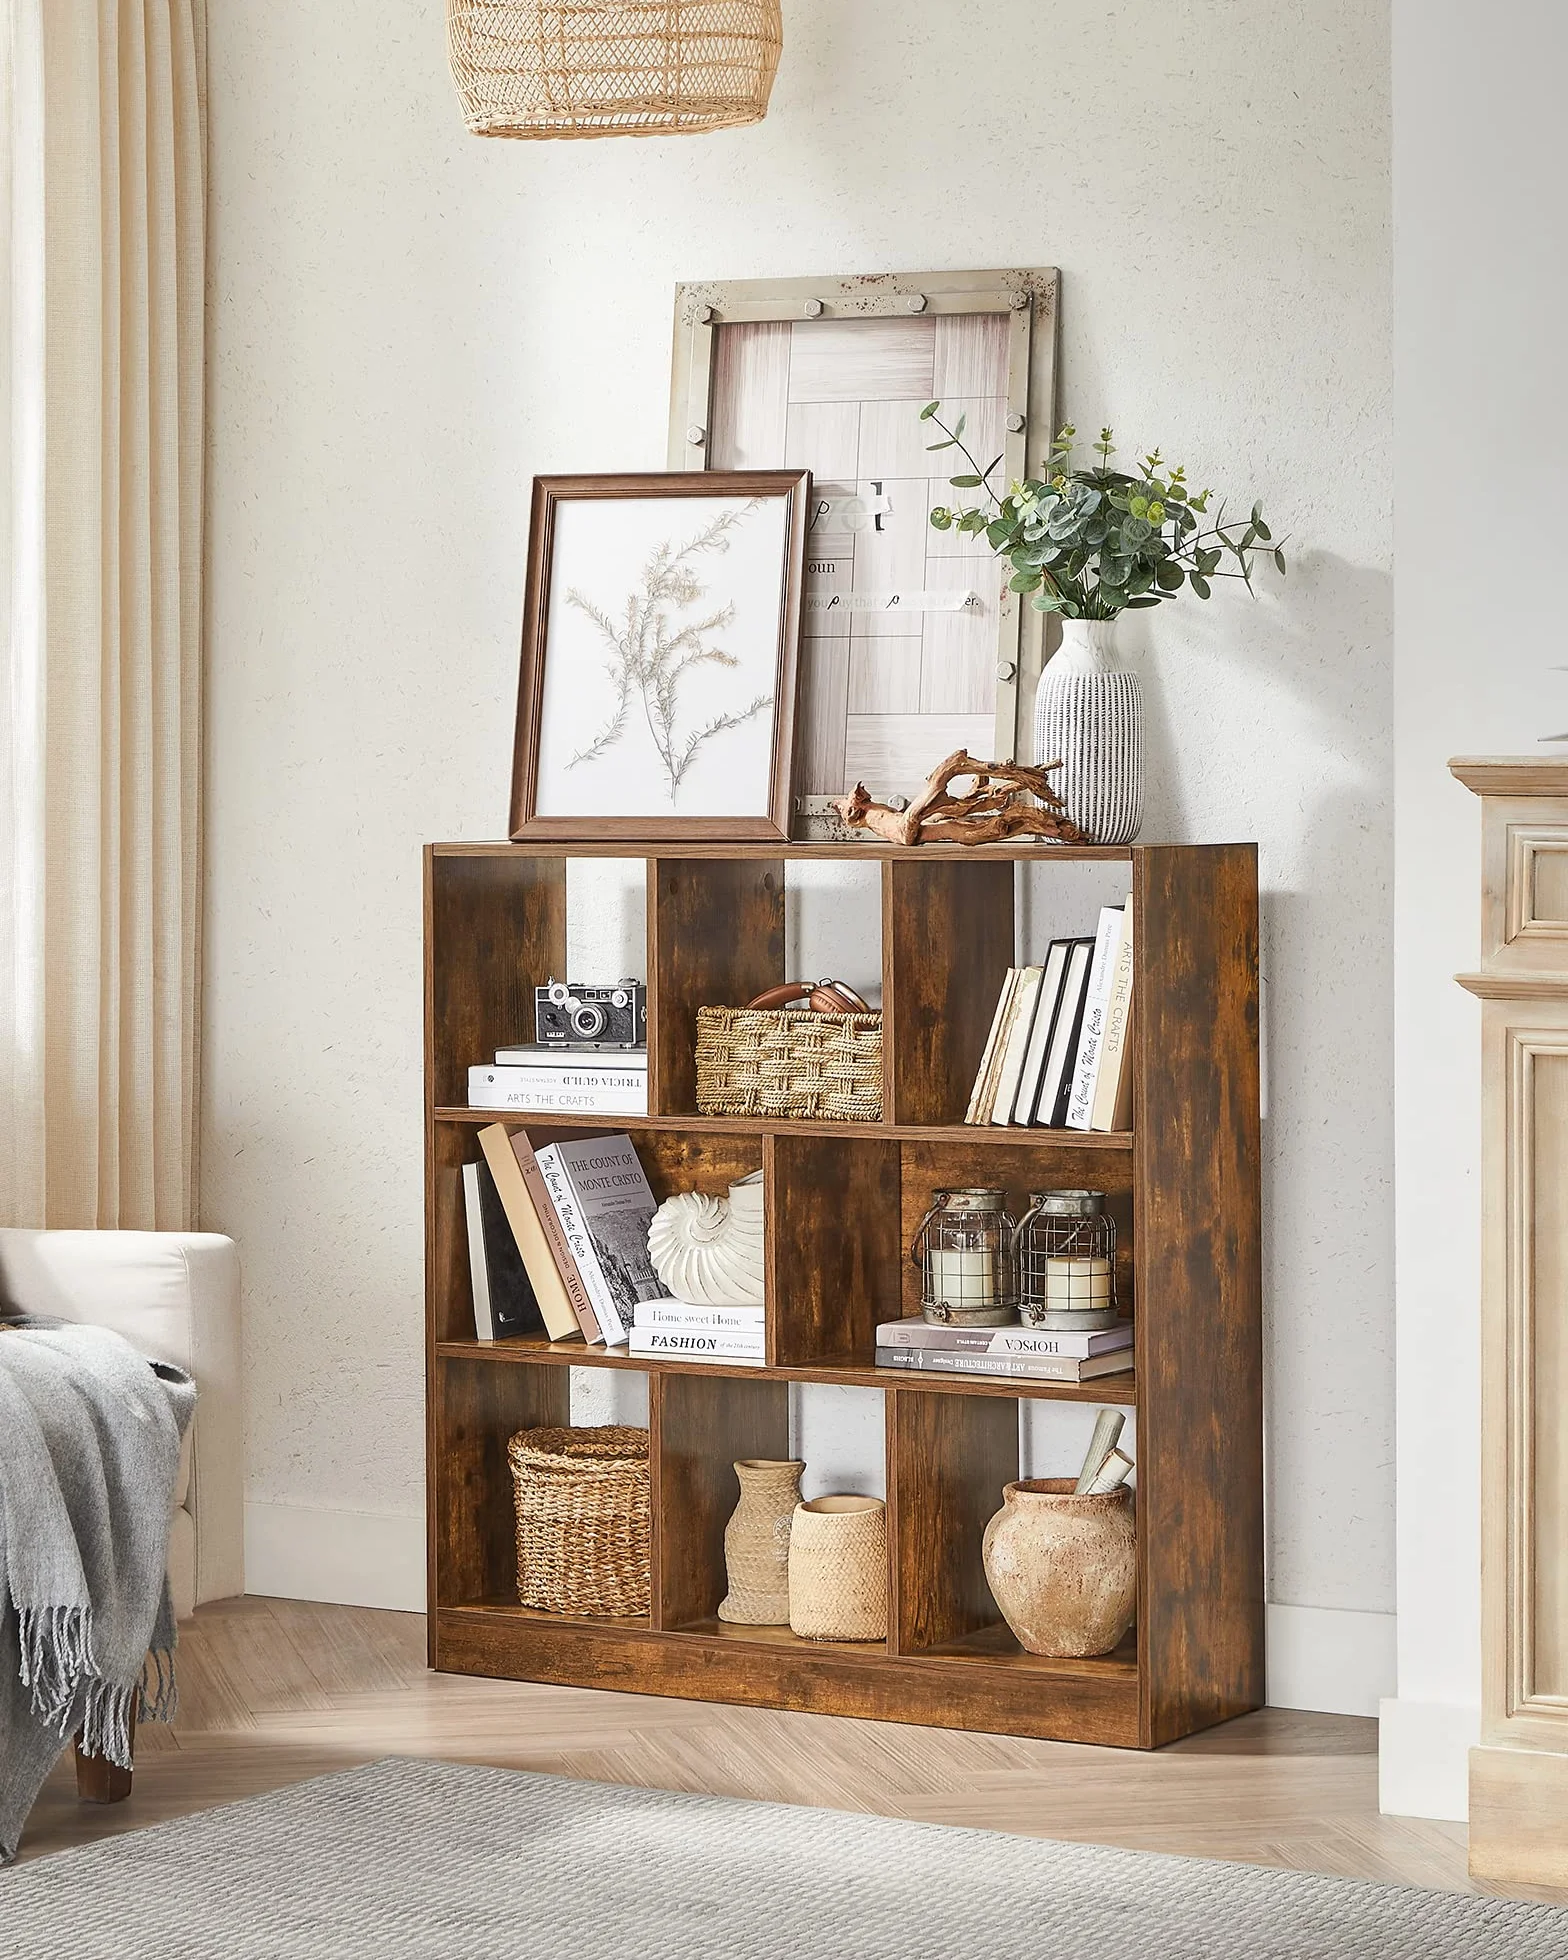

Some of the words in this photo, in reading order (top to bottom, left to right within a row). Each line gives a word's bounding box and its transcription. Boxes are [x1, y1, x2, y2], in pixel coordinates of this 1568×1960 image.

[1120, 941, 1133, 973] ARTS
[1115, 978, 1128, 1002] THE
[1086, 1008, 1102, 1036] Cristo
[1108, 1007, 1124, 1053] CRAFTS
[1081, 1037, 1098, 1066] Monte
[562, 1075, 599, 1086] GUILD
[601, 1076, 642, 1088] TRICIA
[1080, 1068, 1095, 1081] of
[507, 1093, 531, 1104] ARTS
[535, 1094, 554, 1105] THE
[558, 1095, 595, 1106] CRAFTS
[1074, 1080, 1090, 1106] Count
[1071, 1106, 1086, 1121] The
[541, 1154, 554, 1170] The
[570, 1159, 590, 1173] THE
[590, 1155, 621, 1169] COUNT
[621, 1153, 634, 1165] OF
[545, 1172, 562, 1193] Count
[578, 1178, 611, 1192] MONTE
[612, 1172, 642, 1188] CRISTO
[555, 1193, 568, 1204] of
[541, 1203, 560, 1242] DECORATING
[560, 1204, 575, 1232] Monte
[568, 1234, 585, 1259] Cristo
[558, 1246, 570, 1269] DESIGN
[566, 1273, 587, 1313] HOME
[652, 1310, 682, 1323] Home
[684, 1314, 709, 1324] sweet
[712, 1314, 742, 1326] Home
[650, 1335, 717, 1350] FASHION
[1004, 1338, 1058, 1353] HOPSCA
[1027, 1364, 1050, 1373] Famous
[1051, 1365, 1063, 1374] The
